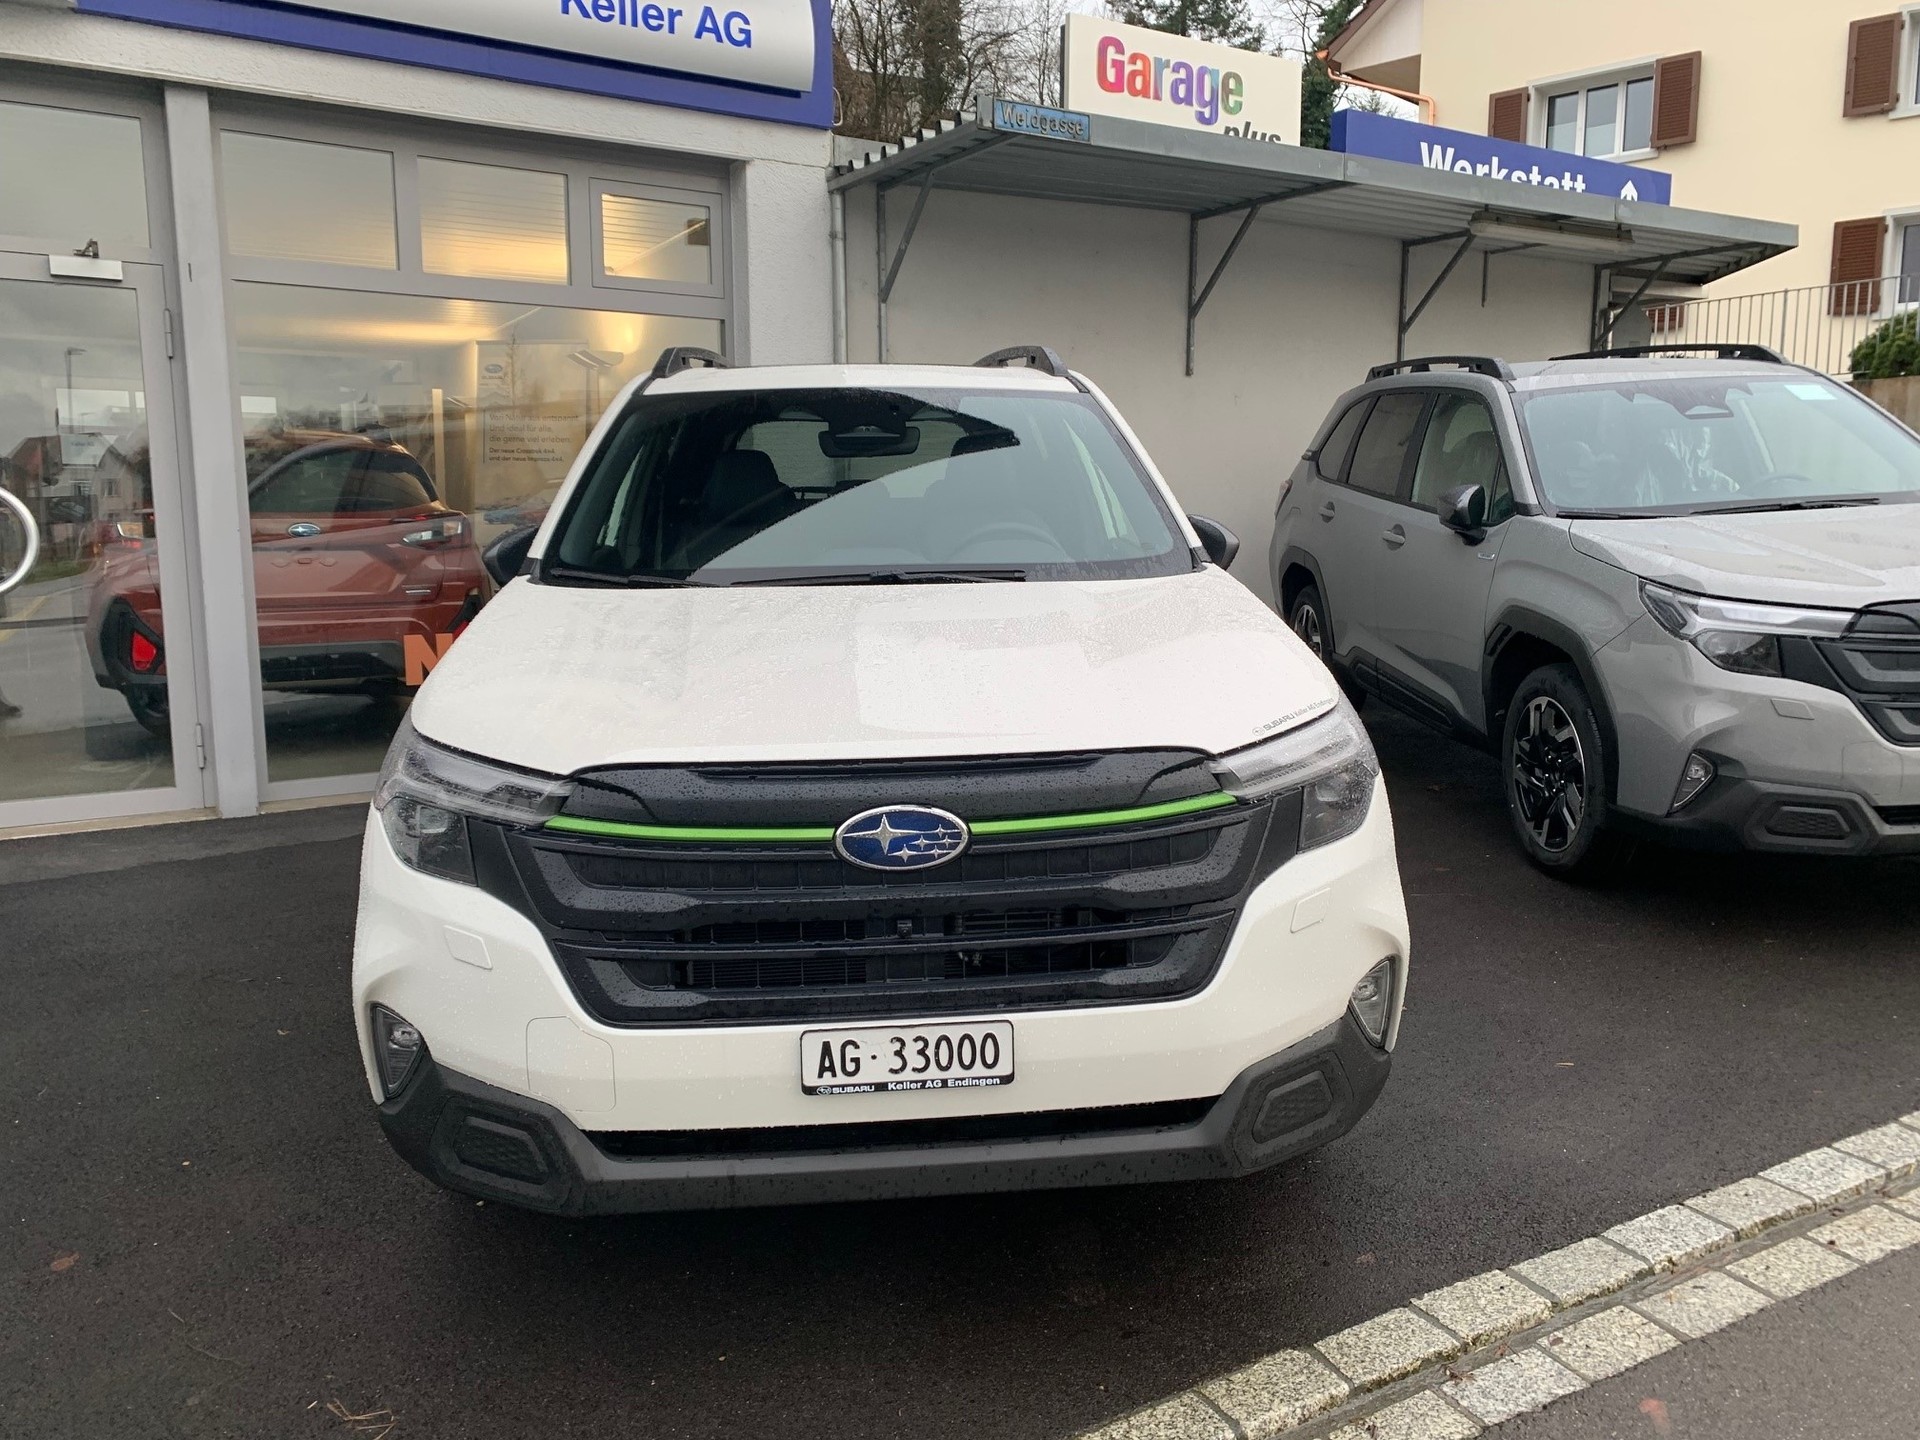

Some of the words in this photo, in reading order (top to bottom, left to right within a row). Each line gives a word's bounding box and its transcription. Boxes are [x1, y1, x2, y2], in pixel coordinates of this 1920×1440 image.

[694, 6, 752, 48] AG
[1097, 36, 1243, 125] Garage
[1001, 101, 1084, 138] Weidgasse
[1263, 713, 1296, 731] SUBARU
[817, 1039, 861, 1079] AG
[888, 1032, 1000, 1075] 33000
[832, 1084, 875, 1094] SUBARU
[887, 1080, 922, 1091] Keller
[924, 1079, 942, 1089] AG
[947, 1077, 1000, 1088] Endingen
